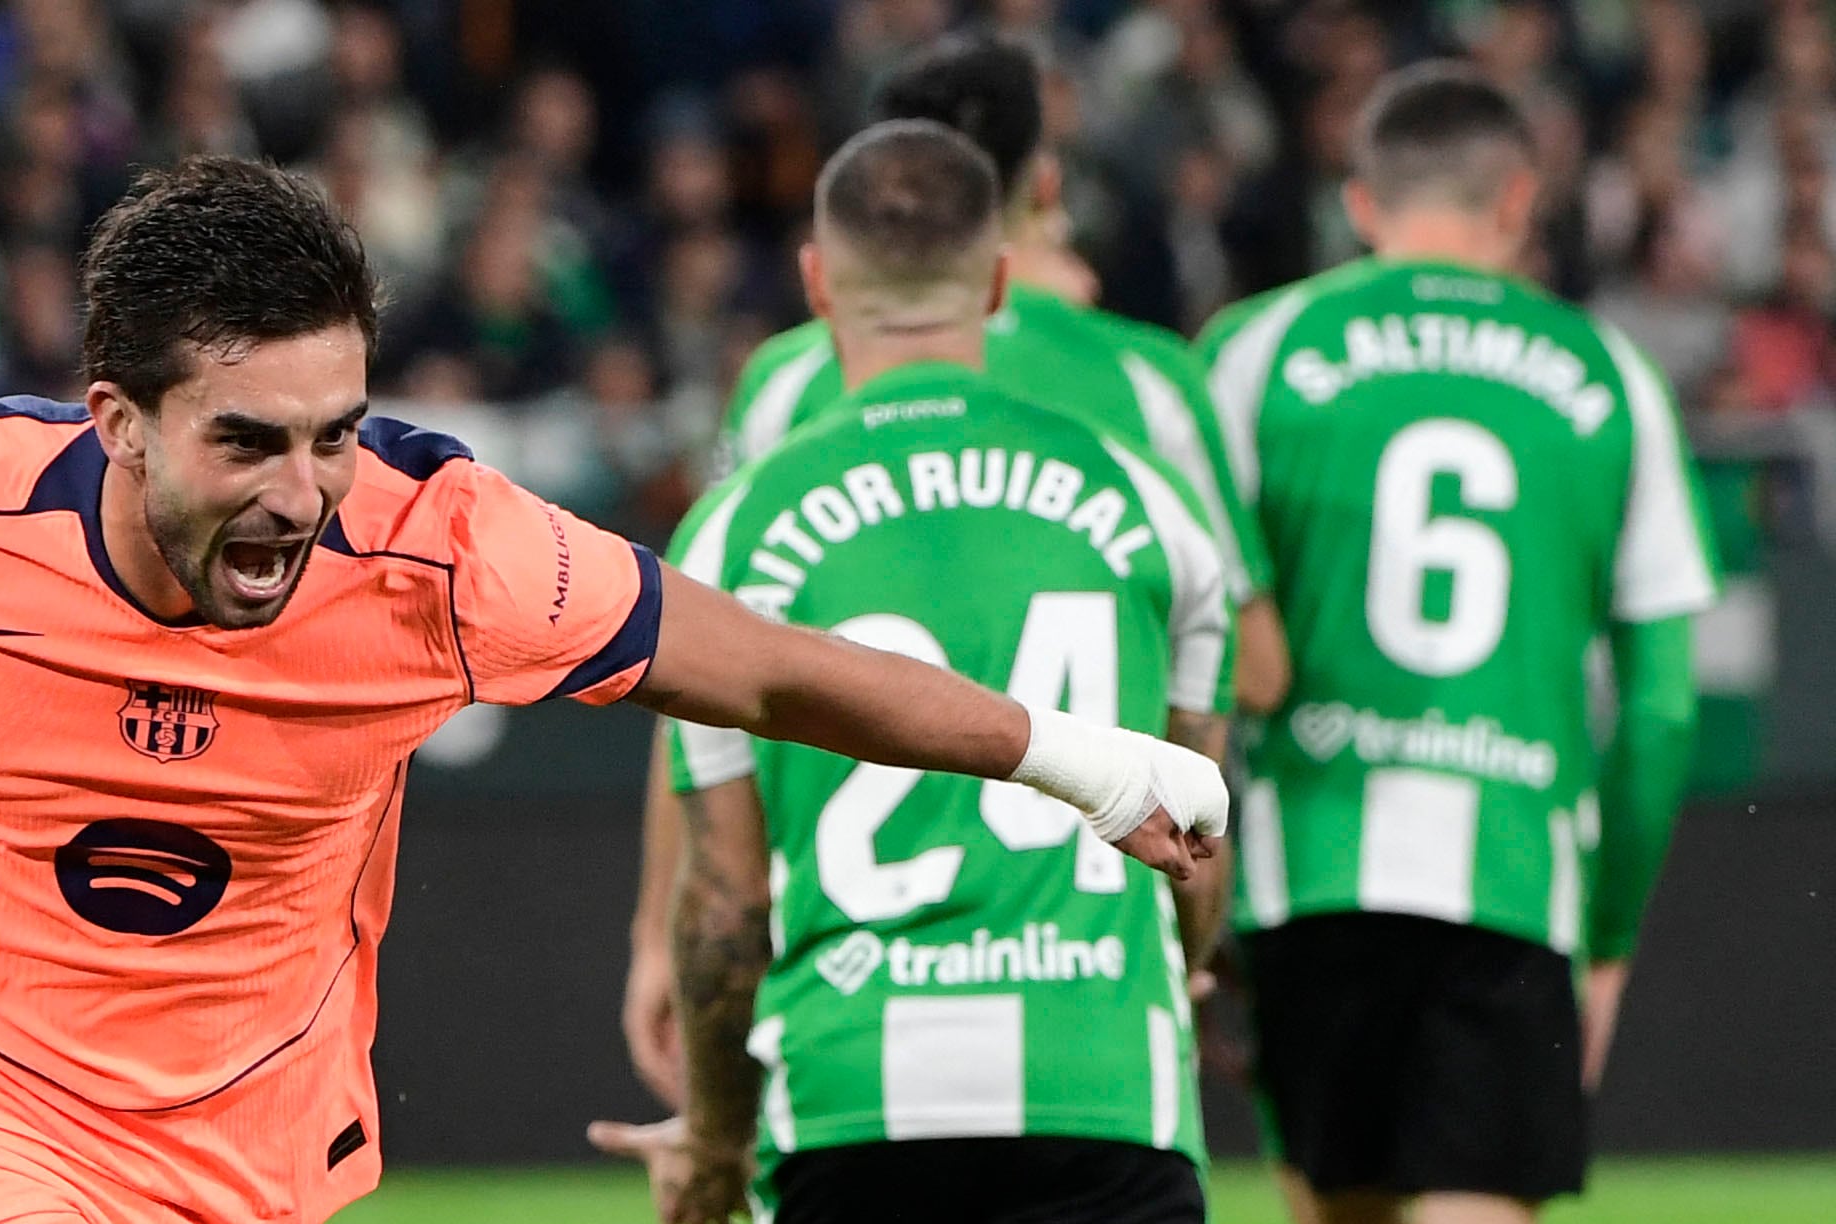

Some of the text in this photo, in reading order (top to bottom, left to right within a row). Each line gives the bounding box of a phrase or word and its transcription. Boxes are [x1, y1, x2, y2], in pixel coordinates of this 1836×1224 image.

[734, 447, 1154, 627] AITOR RUIBAL
[1366, 417, 1519, 677] 6
[815, 591, 1126, 923] 24
[888, 923, 1125, 985] trainline
